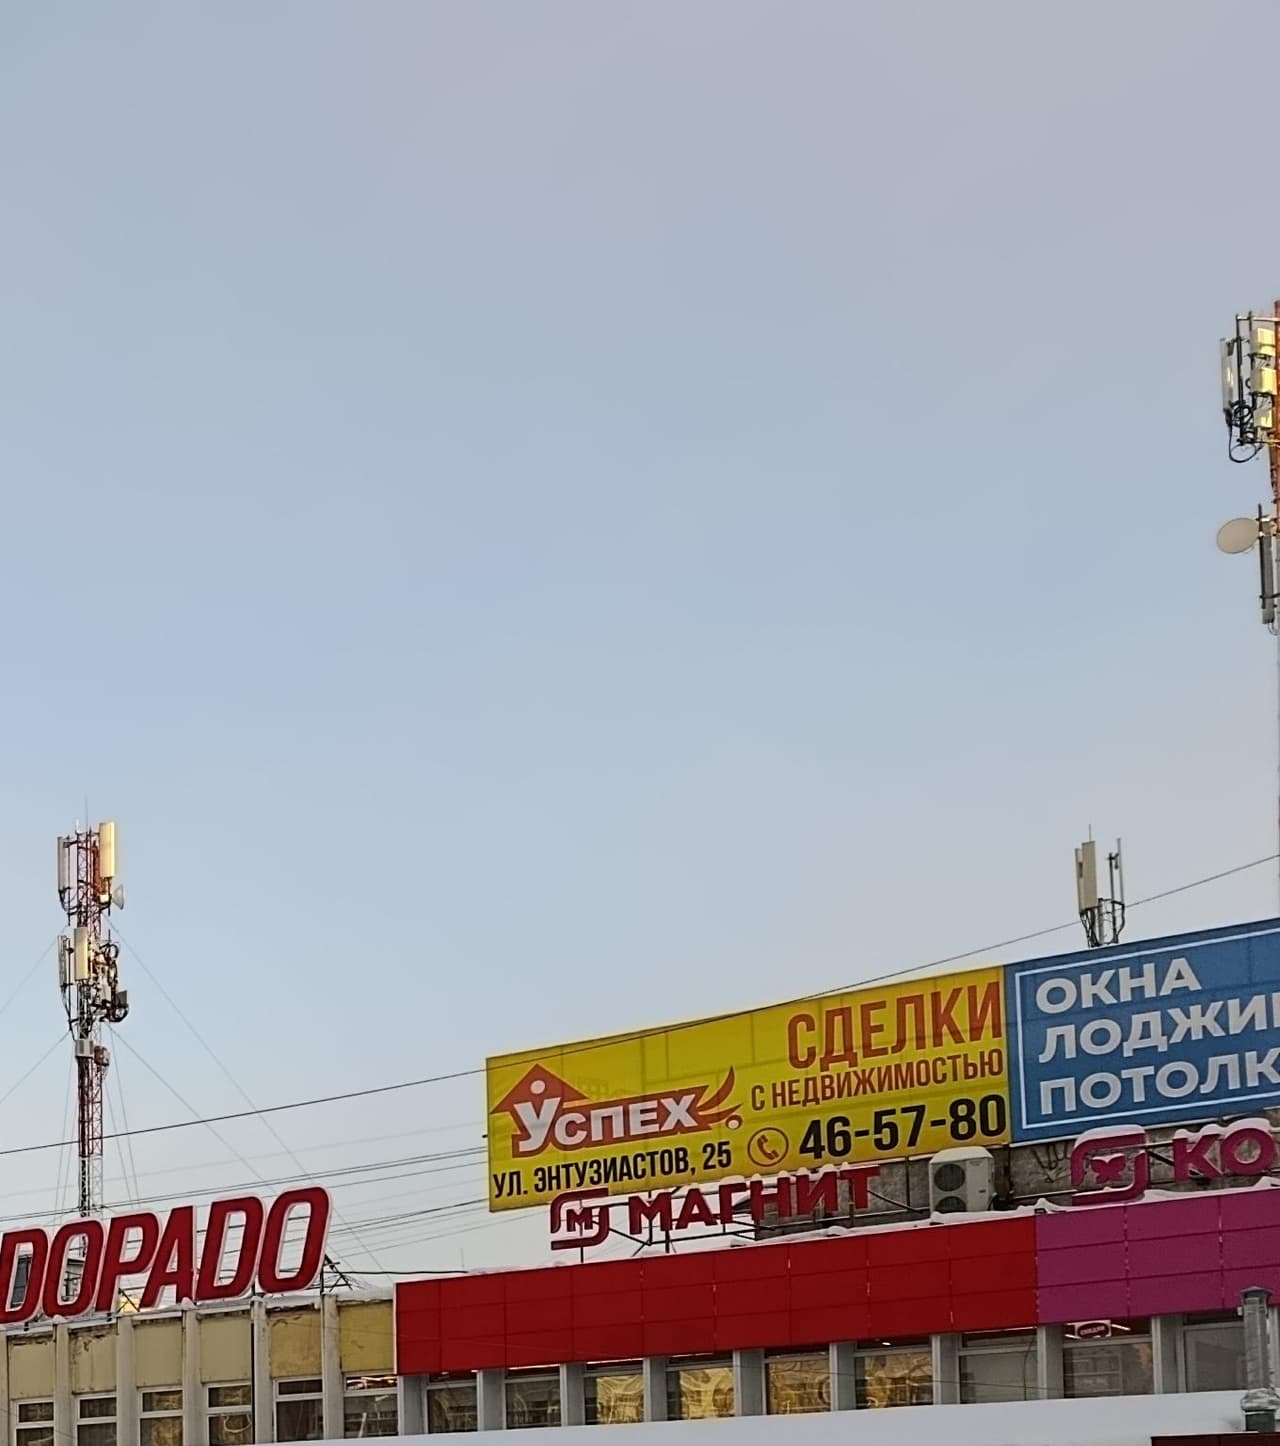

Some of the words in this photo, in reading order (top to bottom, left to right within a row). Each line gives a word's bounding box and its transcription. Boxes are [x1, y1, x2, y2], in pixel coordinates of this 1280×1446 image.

[1036, 957, 1202, 1014] ОКНА
[787, 981, 1002, 1072] СДЕЛКИ
[1039, 992, 1280, 1063] ЛОДЖИ
[751, 1085, 765, 1111] С
[772, 1048, 1003, 1107] НЕДВИЖИМОСТЬЮ
[799, 1094, 1007, 1160] 46-57-80
[493, 1170, 528, 1198] УЛ.
[534, 1147, 695, 1192] ЭНТУЗИАСТОВ,
[702, 1140, 731, 1170] 25
[628, 1165, 880, 1235] МАГНИТ
